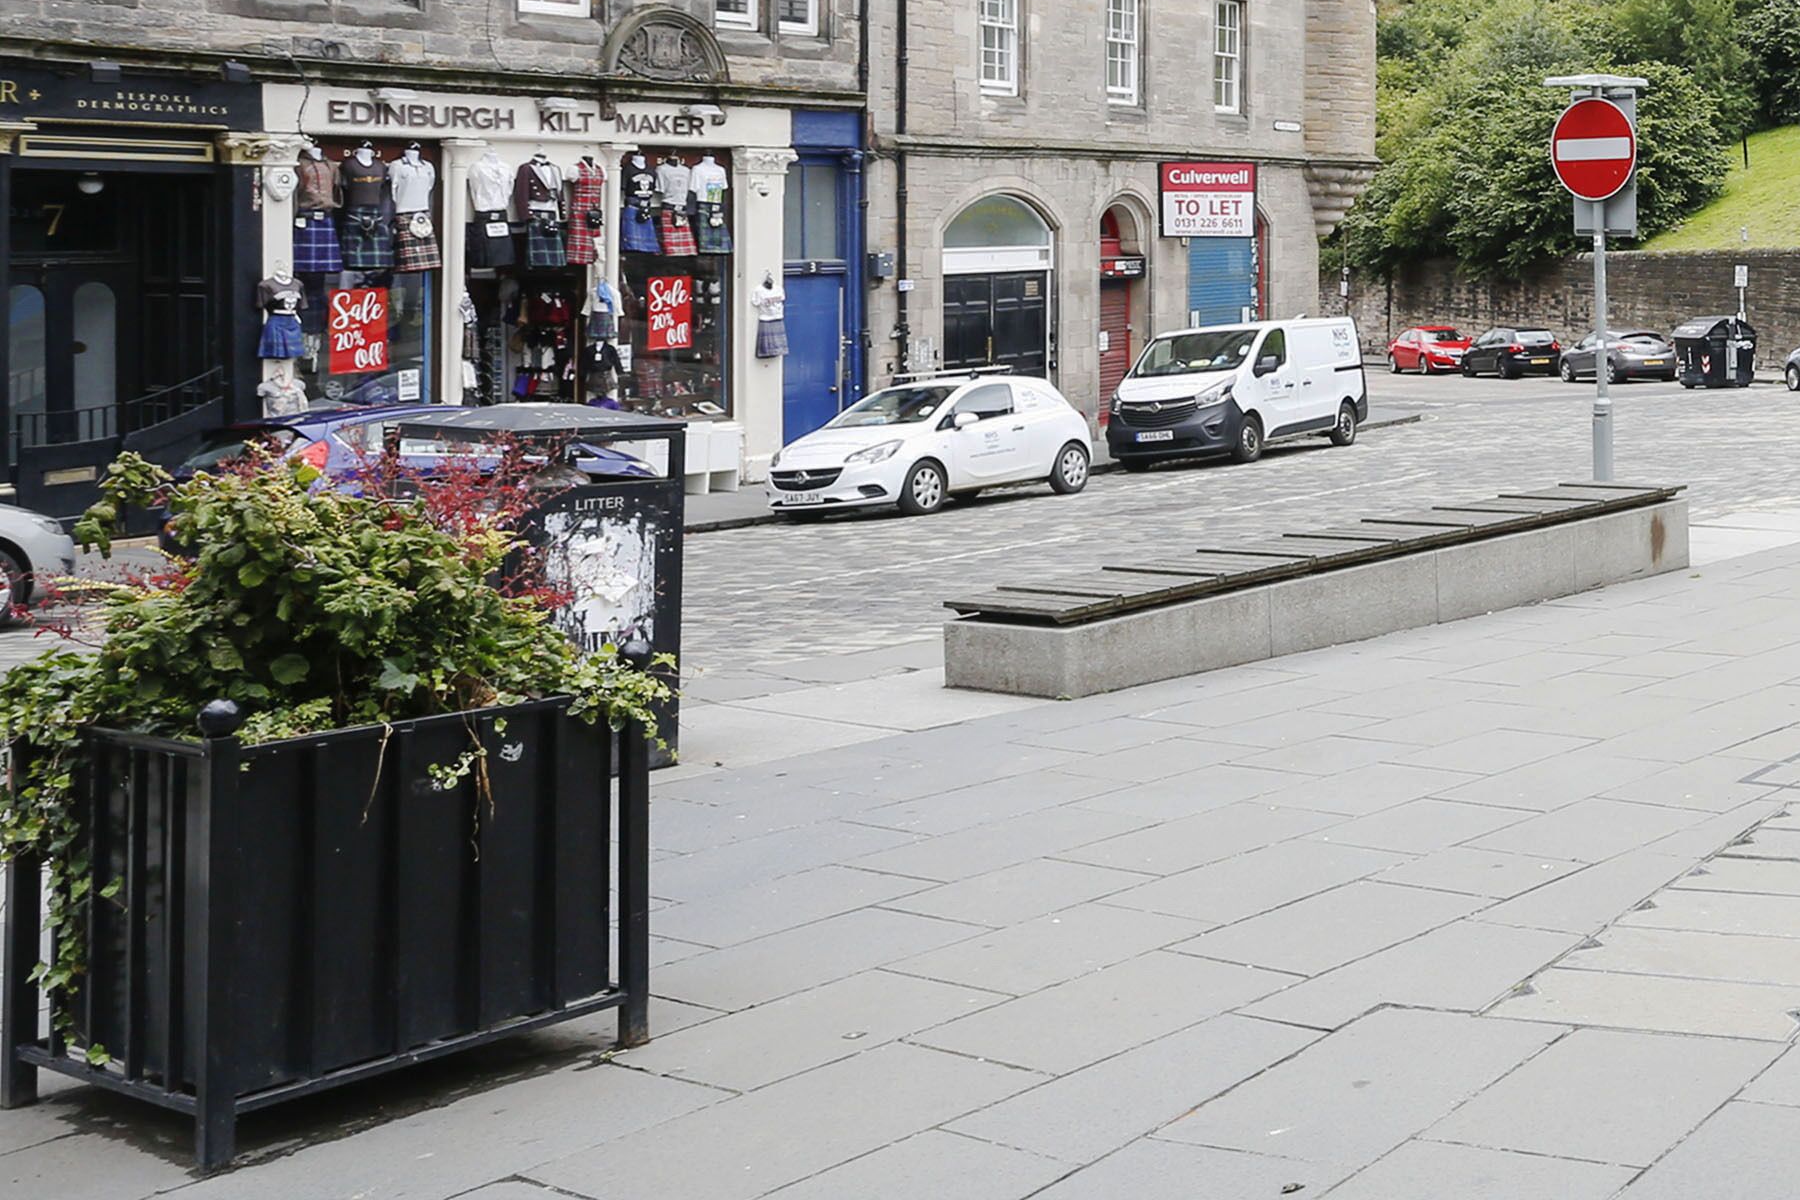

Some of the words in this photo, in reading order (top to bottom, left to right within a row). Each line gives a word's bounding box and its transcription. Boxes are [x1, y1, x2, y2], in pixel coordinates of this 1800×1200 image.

[117, 92, 191, 104] BESPOKE
[78, 101, 228, 115] DERMOGRAPHICS
[328, 101, 515, 130] EDINBURGH
[538, 111, 595, 133] KILT
[615, 113, 705, 136] MAKER
[1169, 169, 1248, 184] Culverwell
[1175, 200, 1200, 215] TO
[1209, 200, 1242, 215] LET
[42, 204, 64, 236] 7
[1175, 218, 1196, 228] 0131
[1200, 218, 1218, 228] 226
[1222, 218, 1243, 228] 6611
[810, 262, 817, 273] 3
[650, 279, 689, 312] Sale
[332, 291, 384, 329] Sale
[651, 312, 674, 331] 20%
[334, 330, 366, 351] 20%
[667, 323, 688, 345] Off
[1331, 328, 1348, 340] NHS
[354, 341, 384, 368] Off
[575, 496, 624, 511] LITTER
